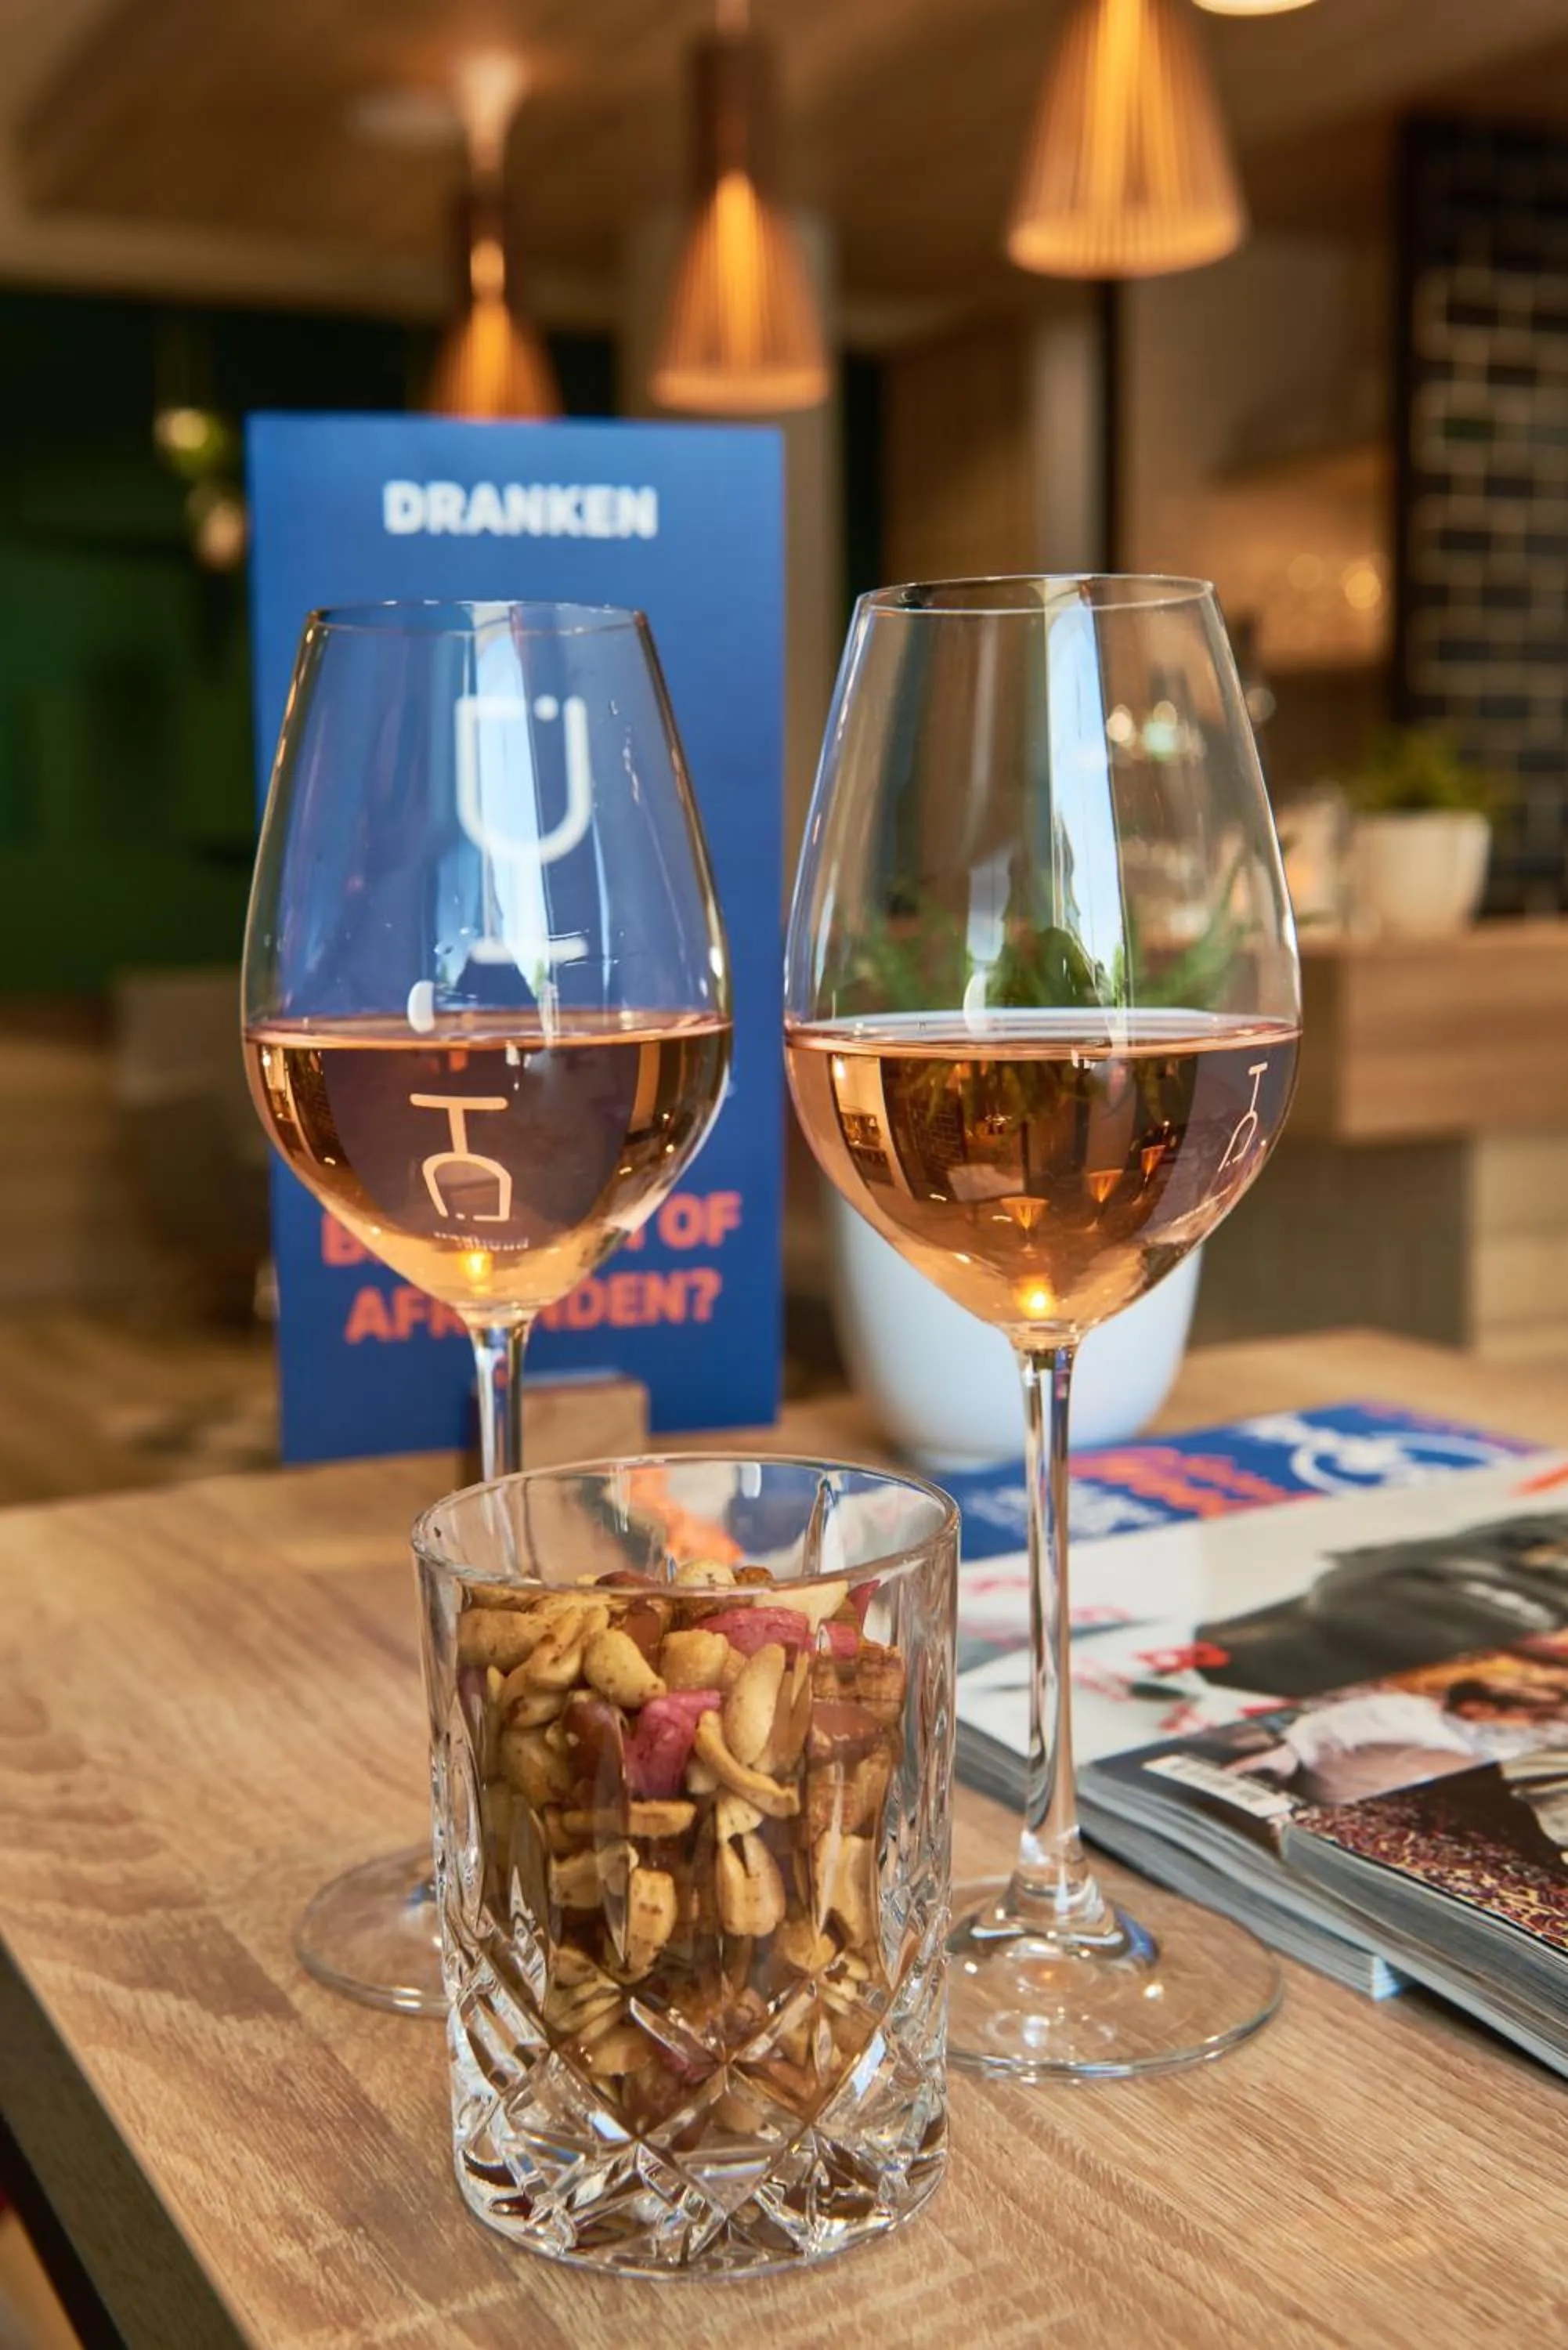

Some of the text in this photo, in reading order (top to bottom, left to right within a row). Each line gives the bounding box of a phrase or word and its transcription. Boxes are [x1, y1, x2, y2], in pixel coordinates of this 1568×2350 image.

[383, 479, 658, 539] DRANKEN
[658, 1191, 742, 1250] OF
[345, 1267, 722, 1345] AFRDEN?
